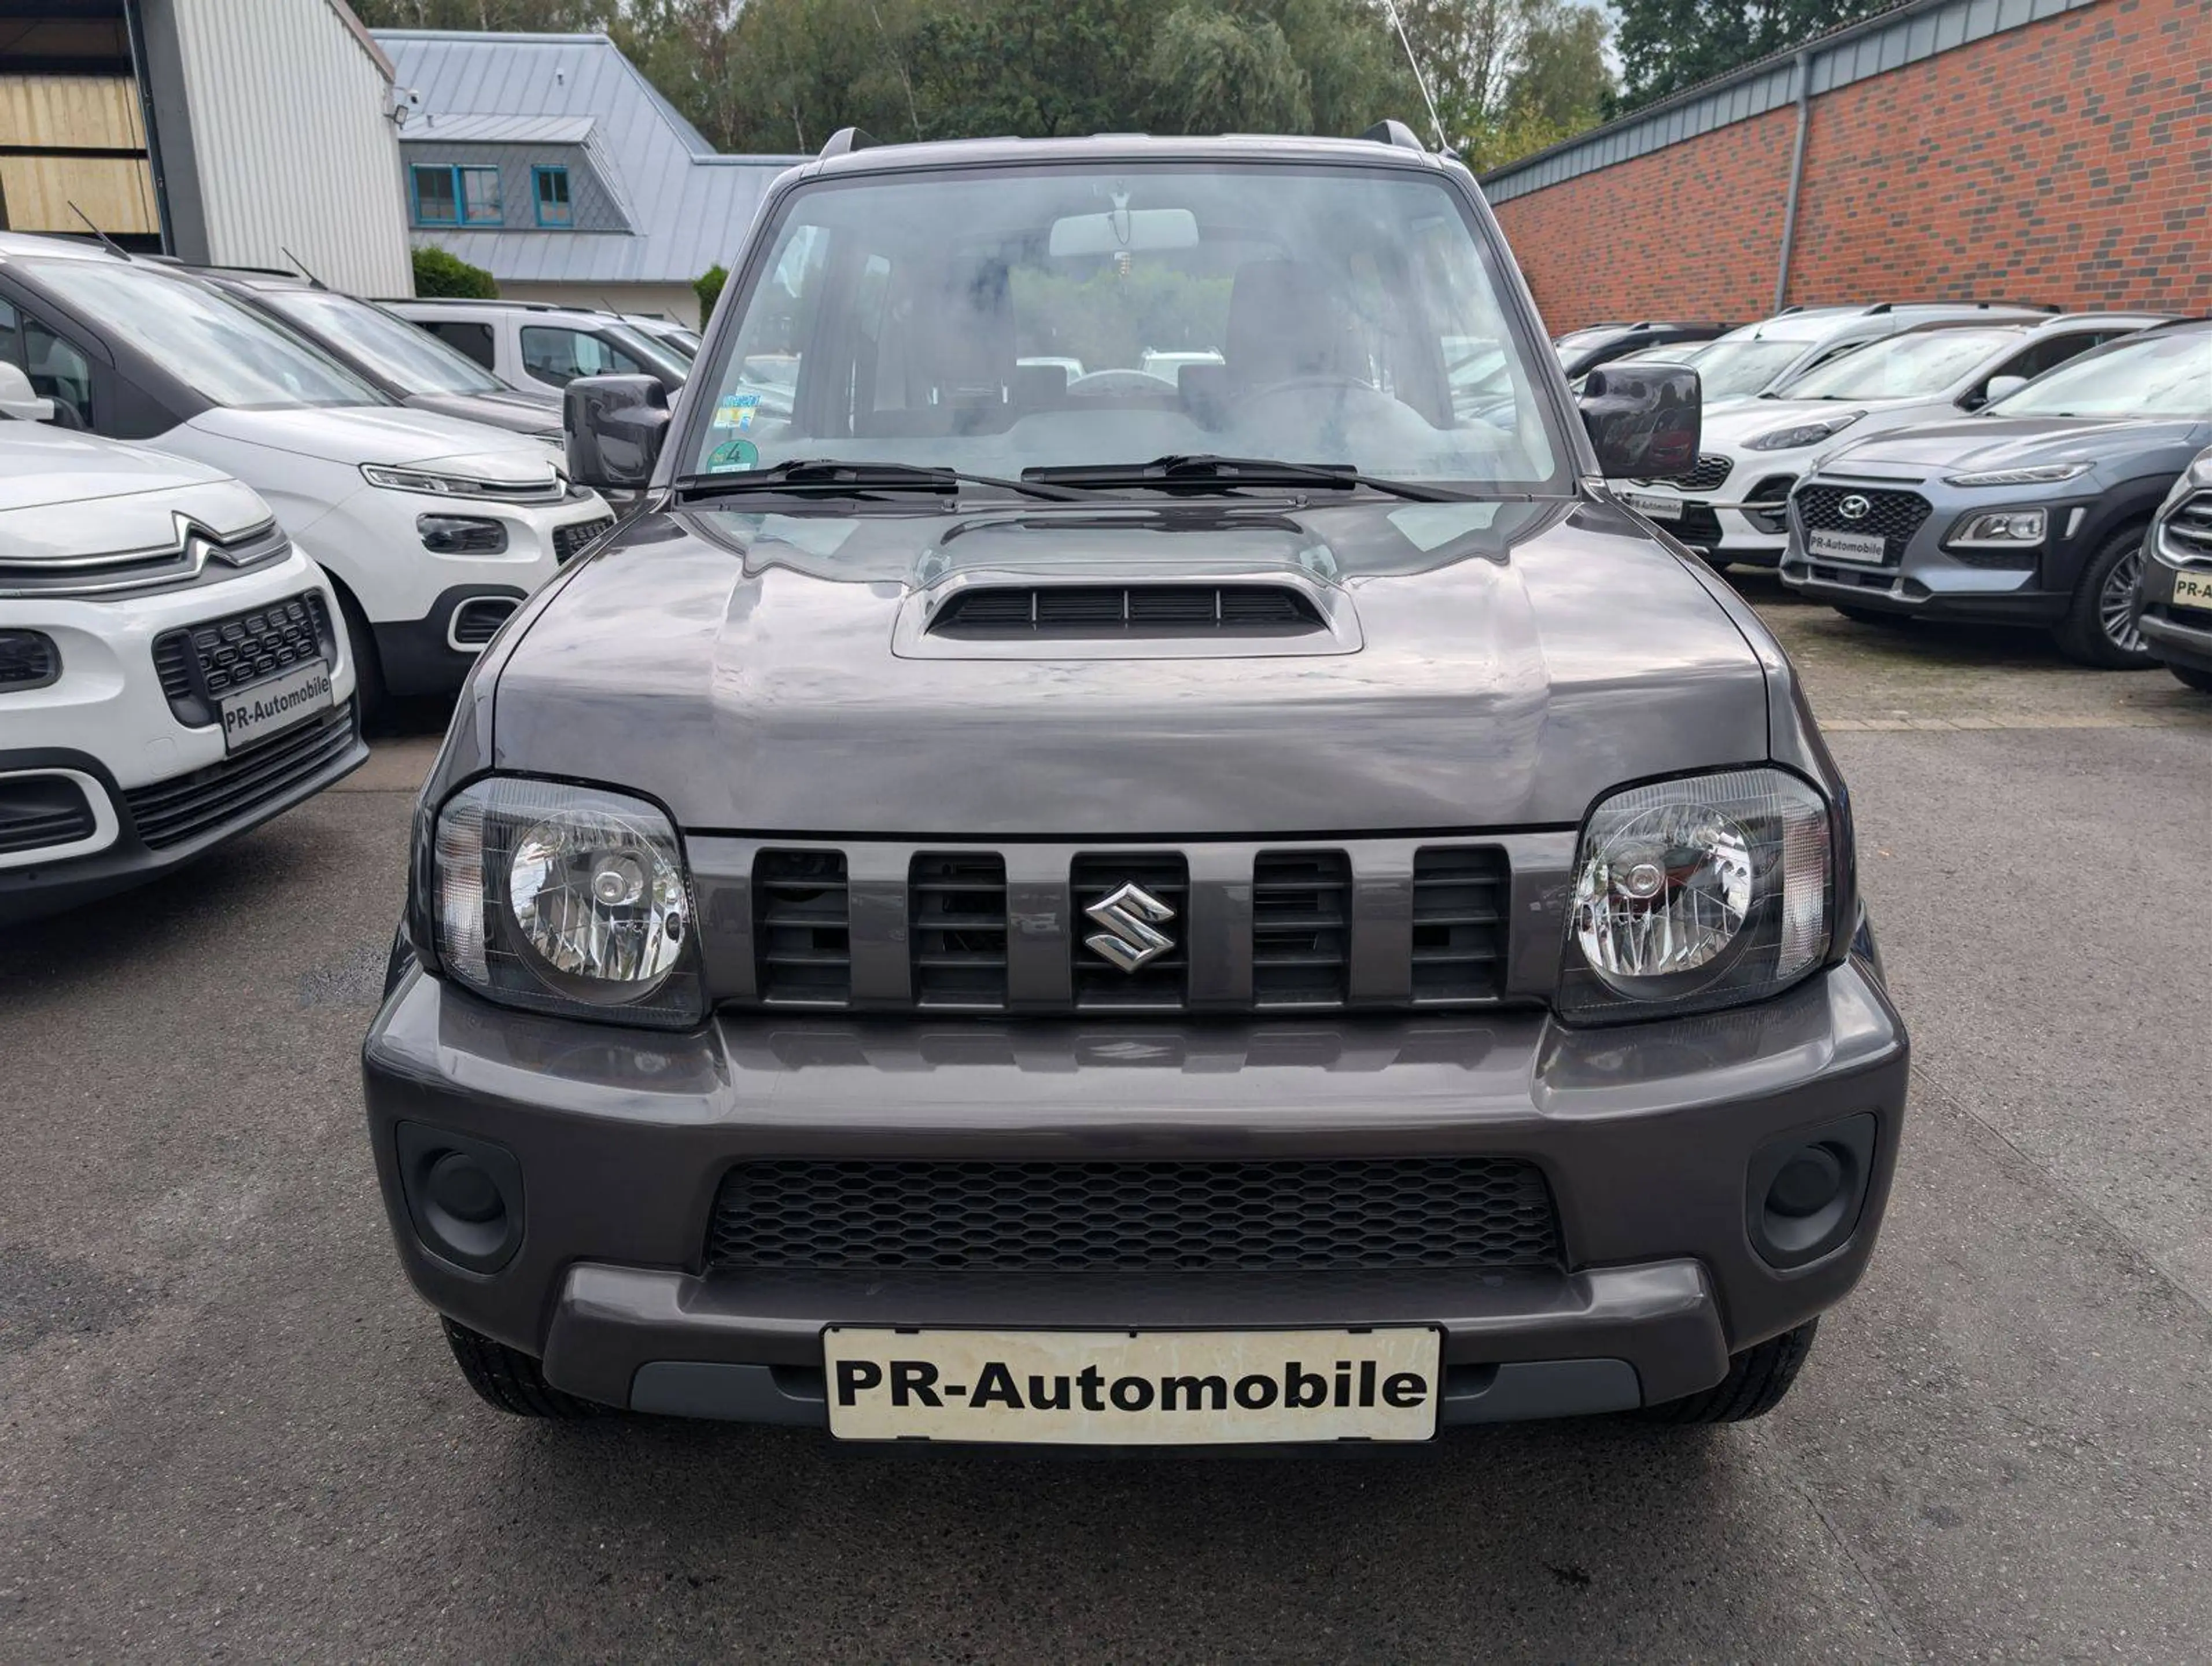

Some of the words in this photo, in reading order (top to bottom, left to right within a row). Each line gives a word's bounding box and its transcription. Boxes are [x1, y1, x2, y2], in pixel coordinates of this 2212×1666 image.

[1811, 536, 1882, 556] PR-Automobile
[225, 675, 329, 734] PR-Automobile
[836, 1359, 1428, 1412] PR-Automobile
